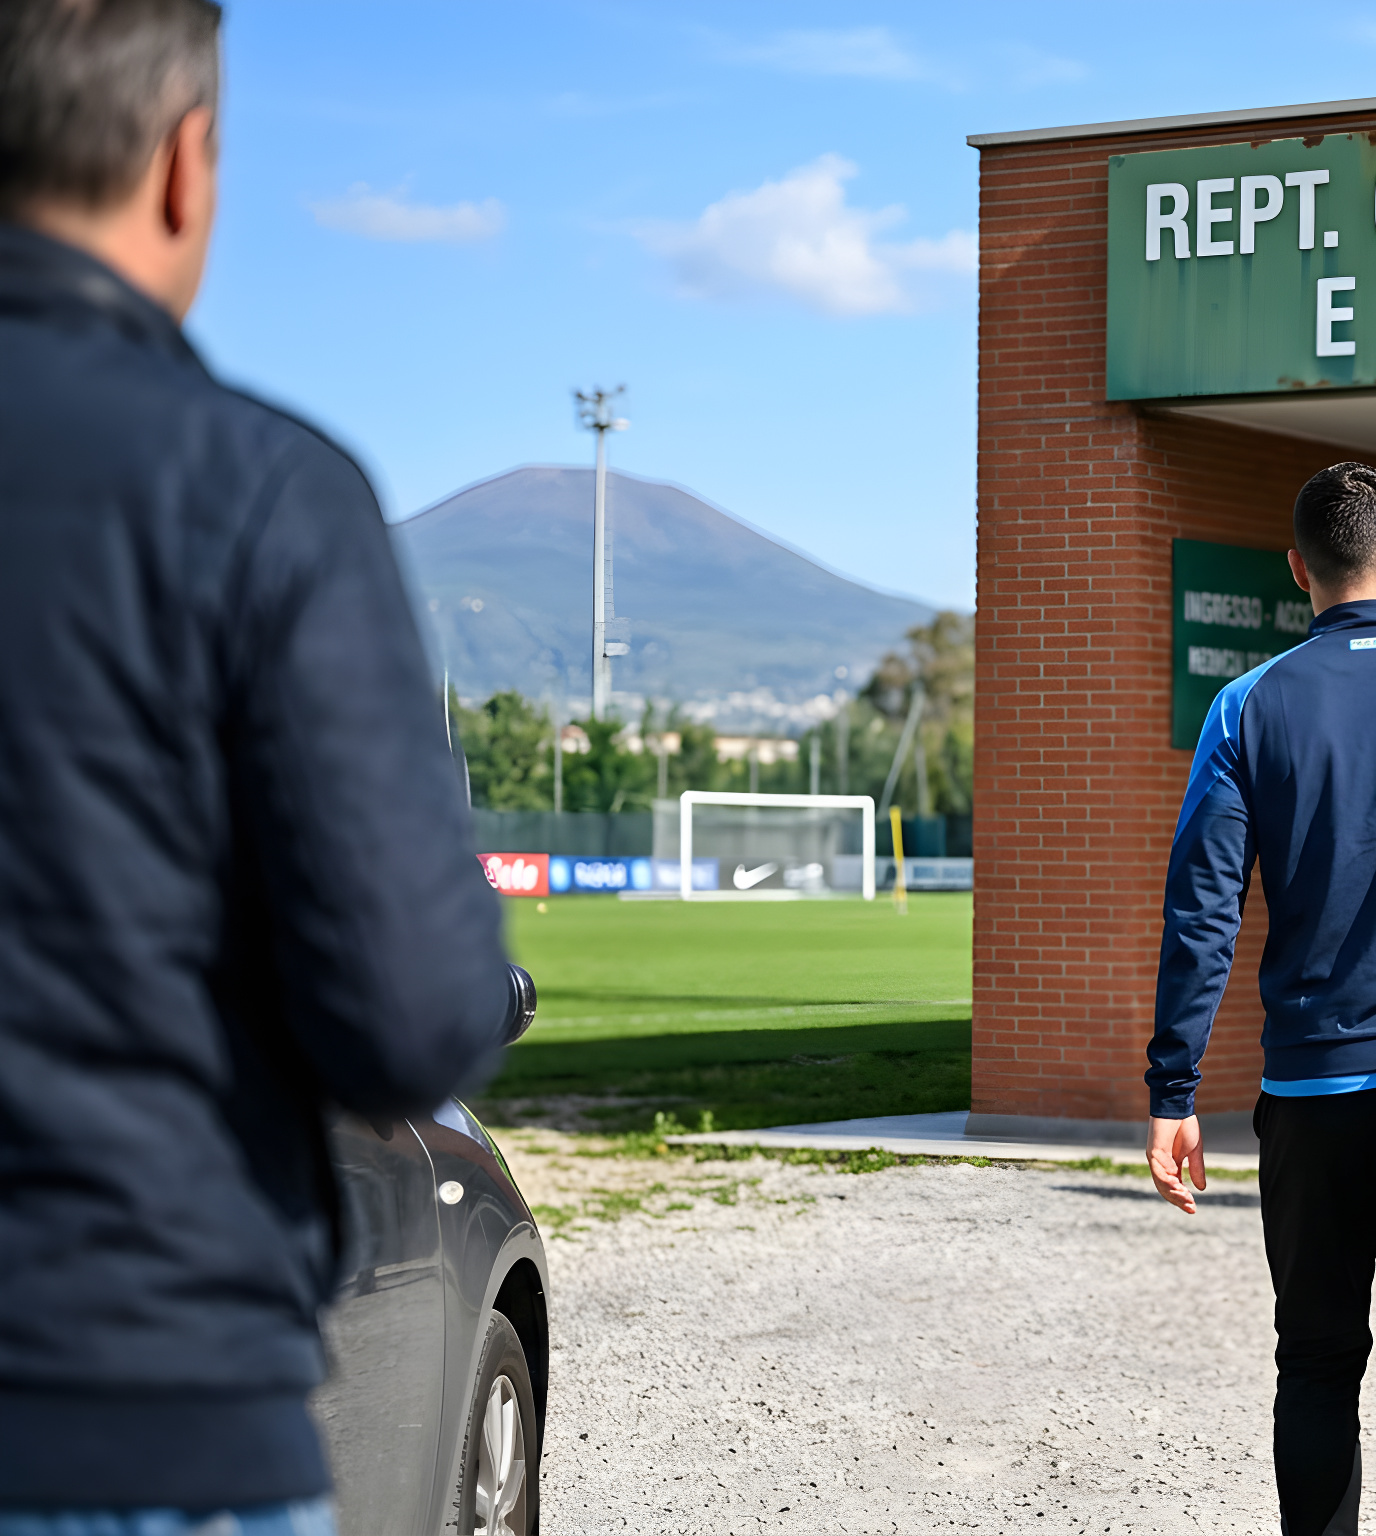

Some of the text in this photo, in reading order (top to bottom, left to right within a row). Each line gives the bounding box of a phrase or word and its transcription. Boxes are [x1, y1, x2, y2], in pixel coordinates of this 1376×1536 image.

[1145, 169, 1339, 261] REPT.
[1316, 276, 1356, 357] E
[1184, 589, 1262, 630] INGRESSO
